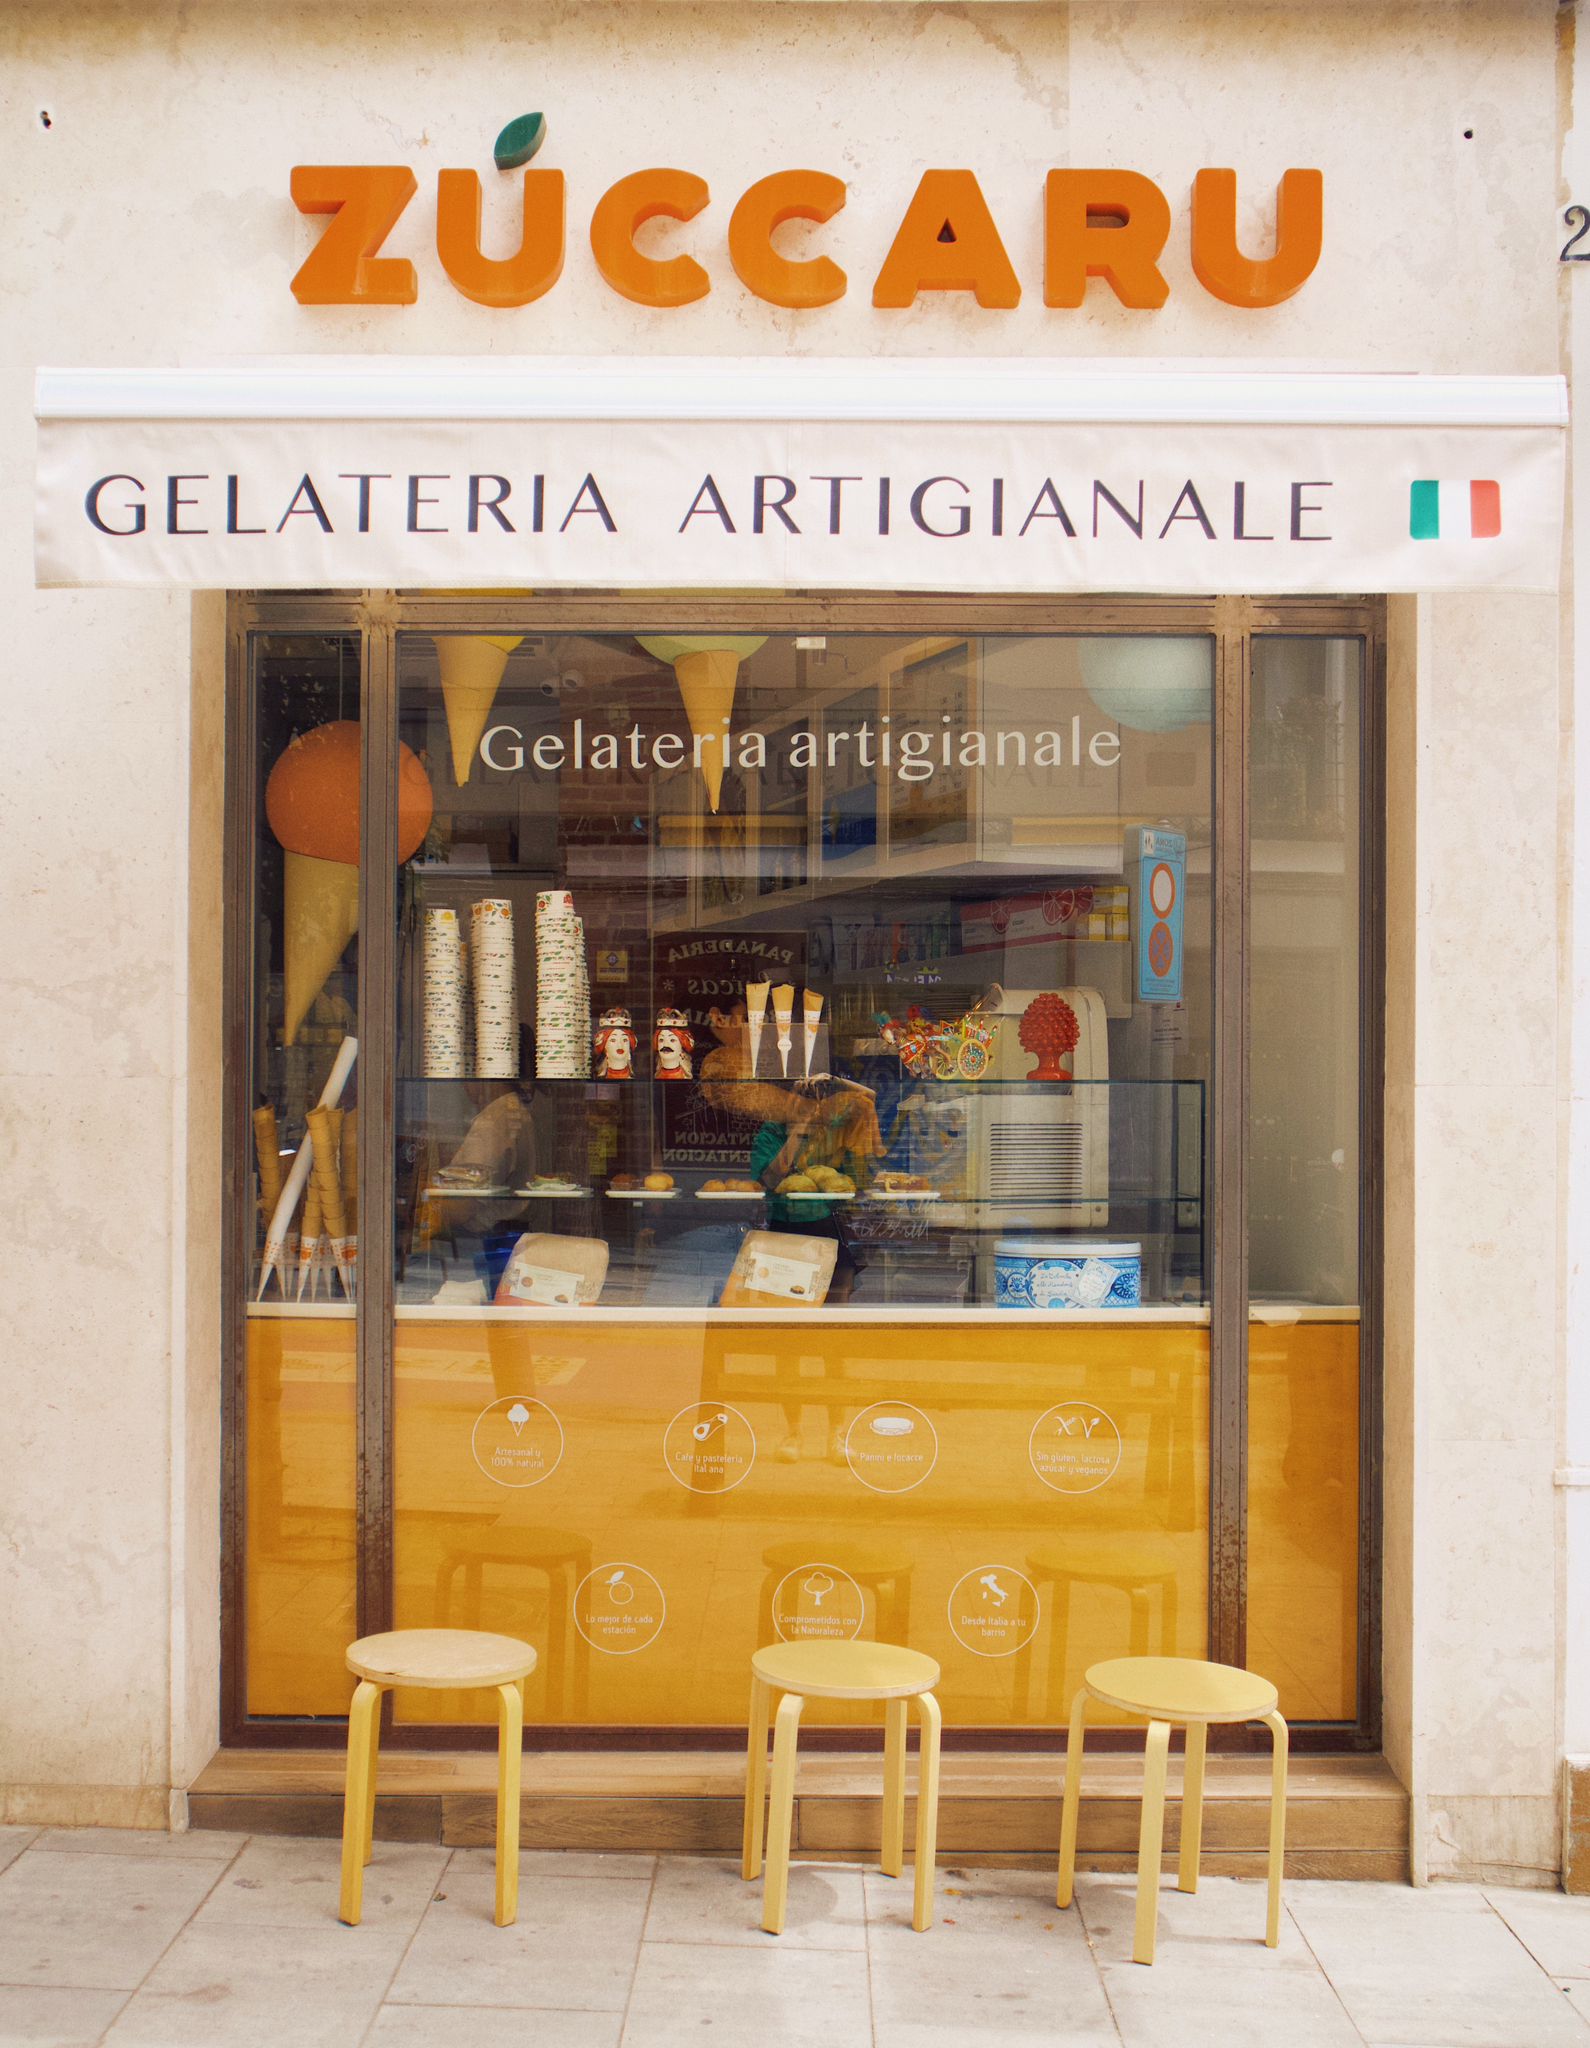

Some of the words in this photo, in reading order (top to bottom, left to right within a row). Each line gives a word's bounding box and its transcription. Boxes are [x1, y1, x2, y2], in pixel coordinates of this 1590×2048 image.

[85, 473, 618, 536] GELATERIA
[679, 474, 1333, 540] ARTIGIANALE
[479, 717, 766, 771] Gelateria
[789, 715, 1121, 781] artigianale
[495, 1447, 533, 1457] Artesanal
[1036, 1451, 1048, 1462] Sin
[491, 1457, 513, 1468] 100%
[515, 1458, 545, 1470] natural
[585, 1613, 595, 1624] Lo
[597, 1614, 620, 1625] mejor
[622, 1613, 632, 1624] de
[634, 1613, 654, 1624] cada
[779, 1612, 840, 1626] Comprometidos
[842, 1617, 857, 1626] con
[961, 1615, 986, 1626] Desde
[988, 1615, 1009, 1627] Italia
[1017, 1617, 1026, 1627] tu
[791, 1624, 800, 1635] la
[802, 1625, 844, 1637] Naturaleza
[981, 1627, 1006, 1638] barrio
